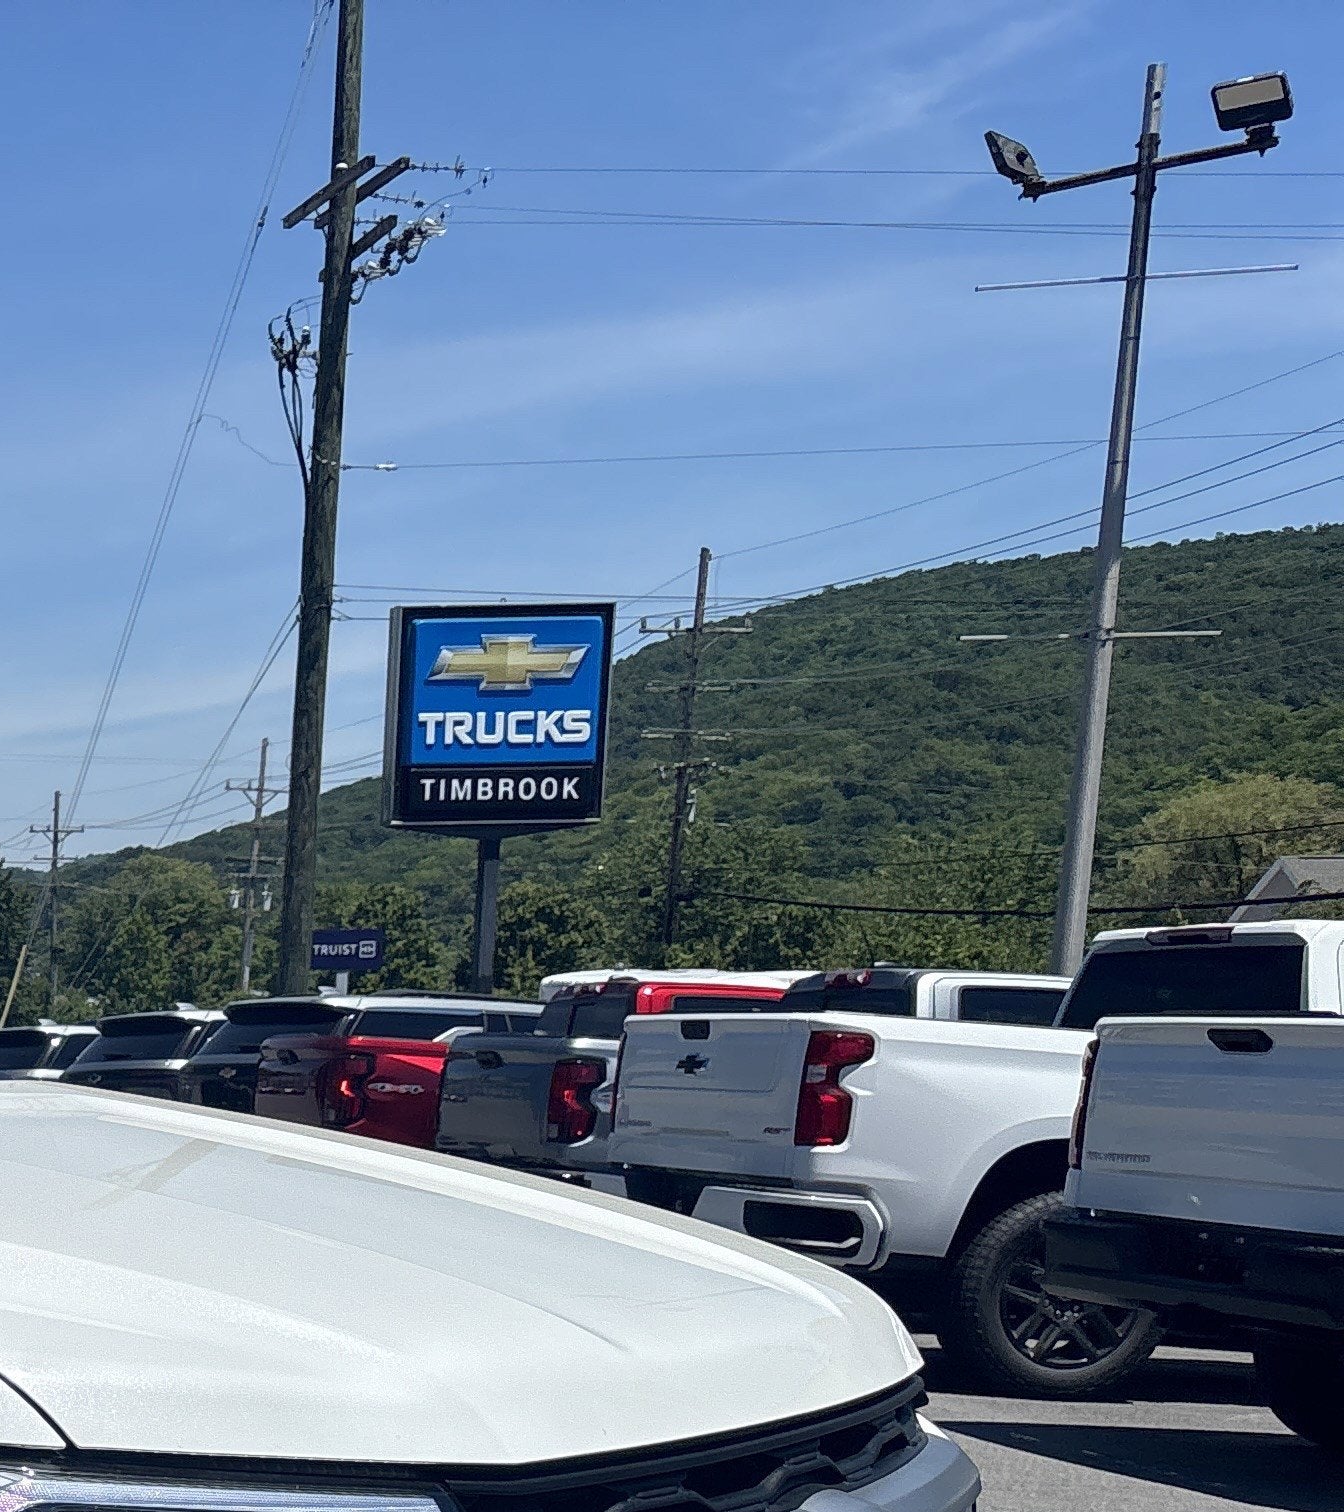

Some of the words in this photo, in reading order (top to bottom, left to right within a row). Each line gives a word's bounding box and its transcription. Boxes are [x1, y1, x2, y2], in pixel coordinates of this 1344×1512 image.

[418, 710, 591, 745] TRUCKS
[420, 776, 580, 801] TIMBROOK
[312, 943, 358, 956] TRUIST
